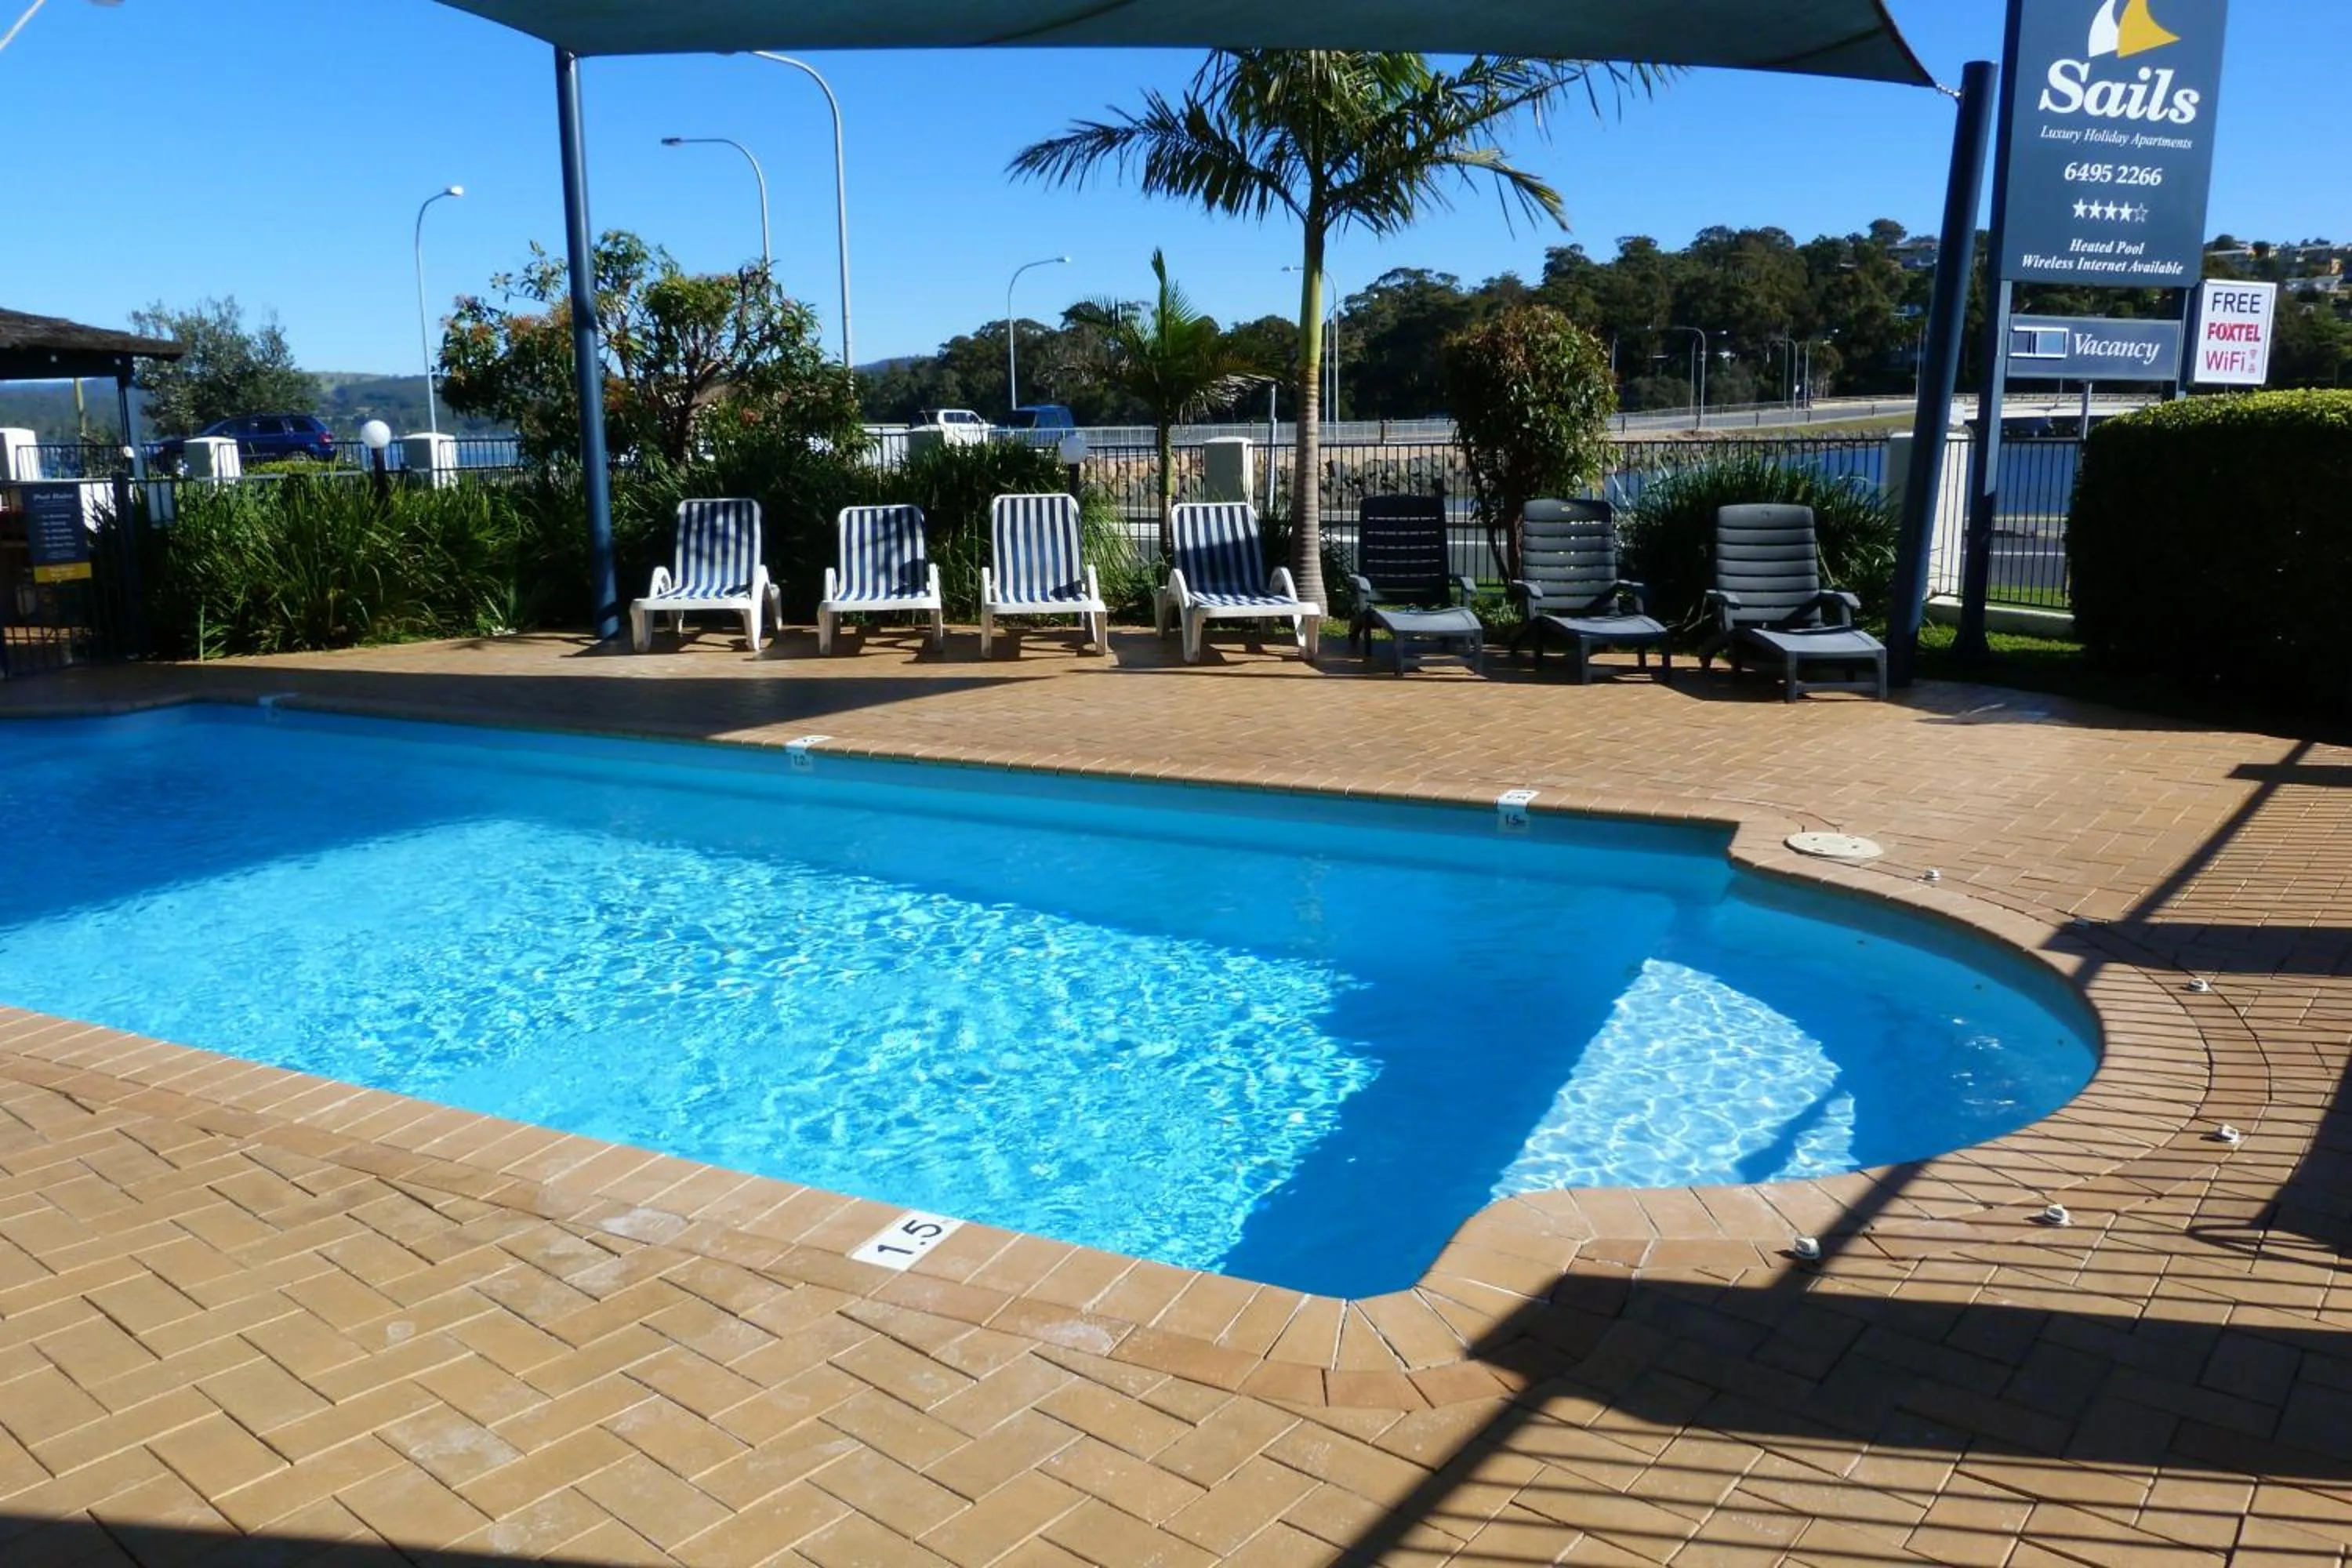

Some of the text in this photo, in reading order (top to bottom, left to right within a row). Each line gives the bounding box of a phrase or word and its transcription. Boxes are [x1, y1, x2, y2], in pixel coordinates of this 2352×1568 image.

[2038, 58, 2201, 125] Sails
[2040, 125, 2193, 150] Luxury Holiday Apartments
[2064, 162, 2162, 187] 6495 2266
[2069, 238, 2145, 256] Heated Pool
[2022, 253, 2183, 276] Wireless Internet Available
[2212, 291, 2262, 314] FREE
[2207, 322, 2261, 343] FOXTEL
[2074, 332, 2161, 365] Vacancy
[2205, 350, 2245, 373] WiFi
[877, 1219, 942, 1255] 1.5
